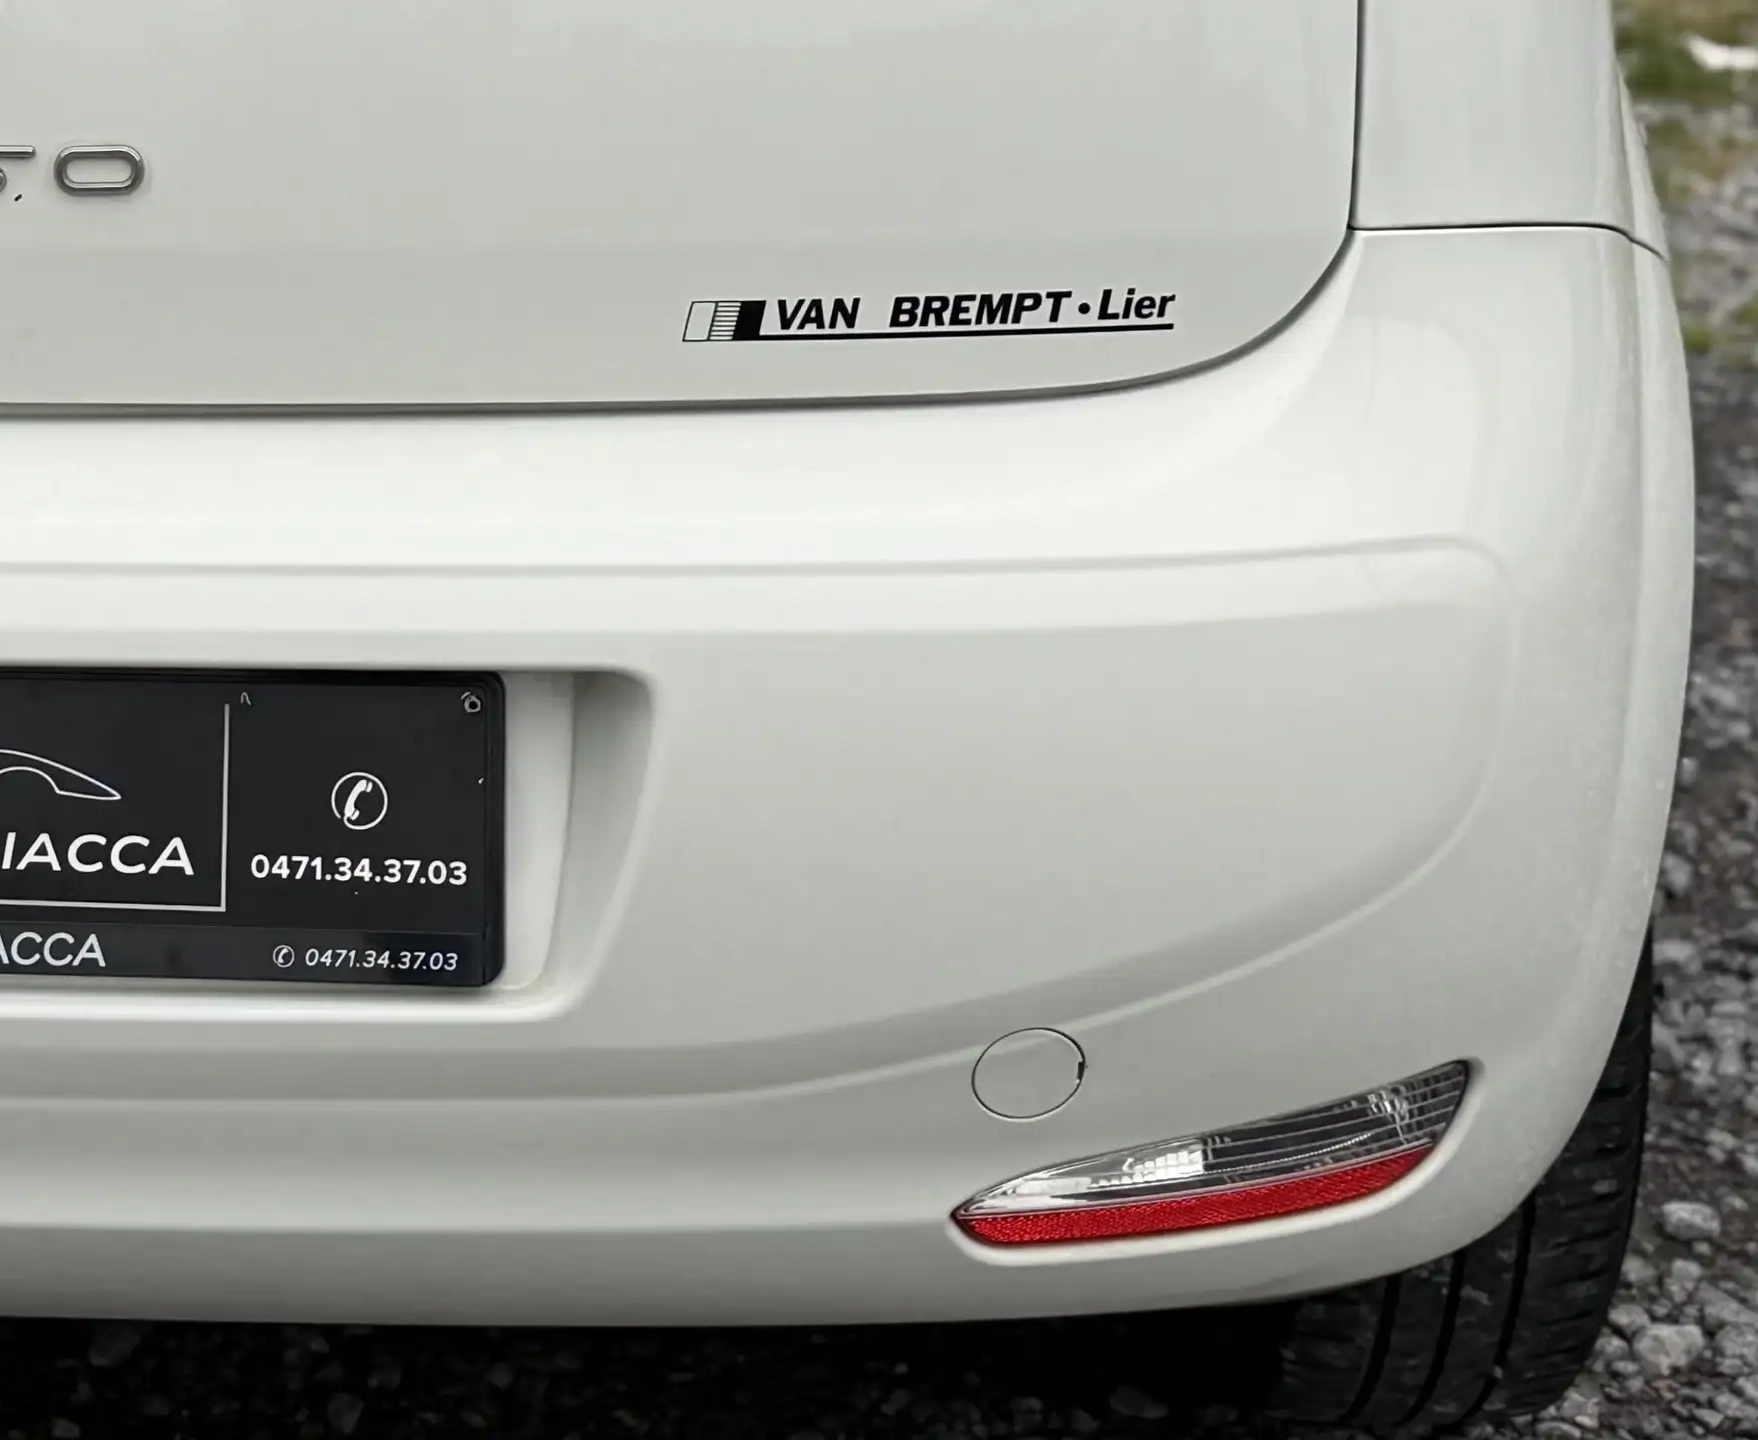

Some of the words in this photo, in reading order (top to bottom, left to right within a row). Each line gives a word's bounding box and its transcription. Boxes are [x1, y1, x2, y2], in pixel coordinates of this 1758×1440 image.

[776, 297, 861, 330] VAN
[250, 853, 468, 886] 0471.34.37.03
[305, 948, 459, 971] 0471.34.37.03
